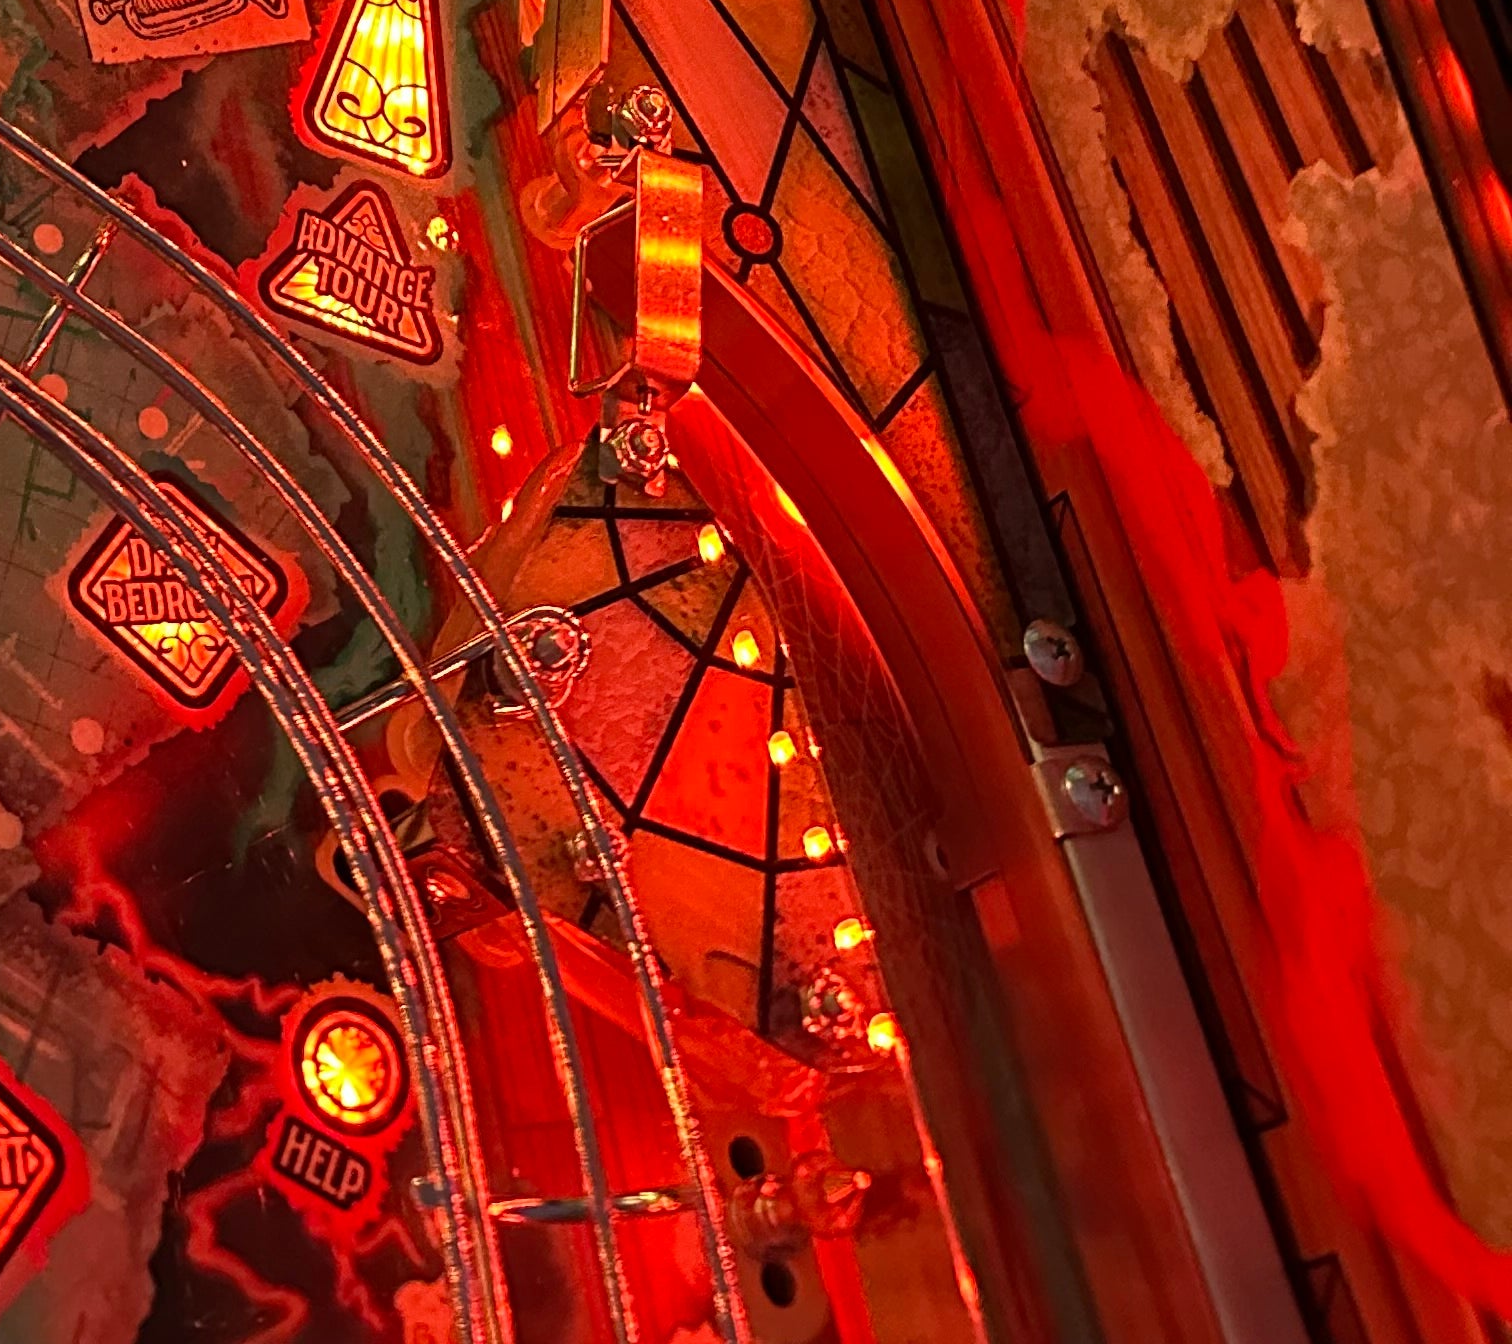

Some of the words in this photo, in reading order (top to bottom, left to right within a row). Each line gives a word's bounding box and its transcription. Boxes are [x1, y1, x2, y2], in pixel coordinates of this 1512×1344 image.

[296, 211, 431, 310] ADVANCE
[318, 256, 400, 334] TOUR
[278, 1126, 367, 1202] HELP
